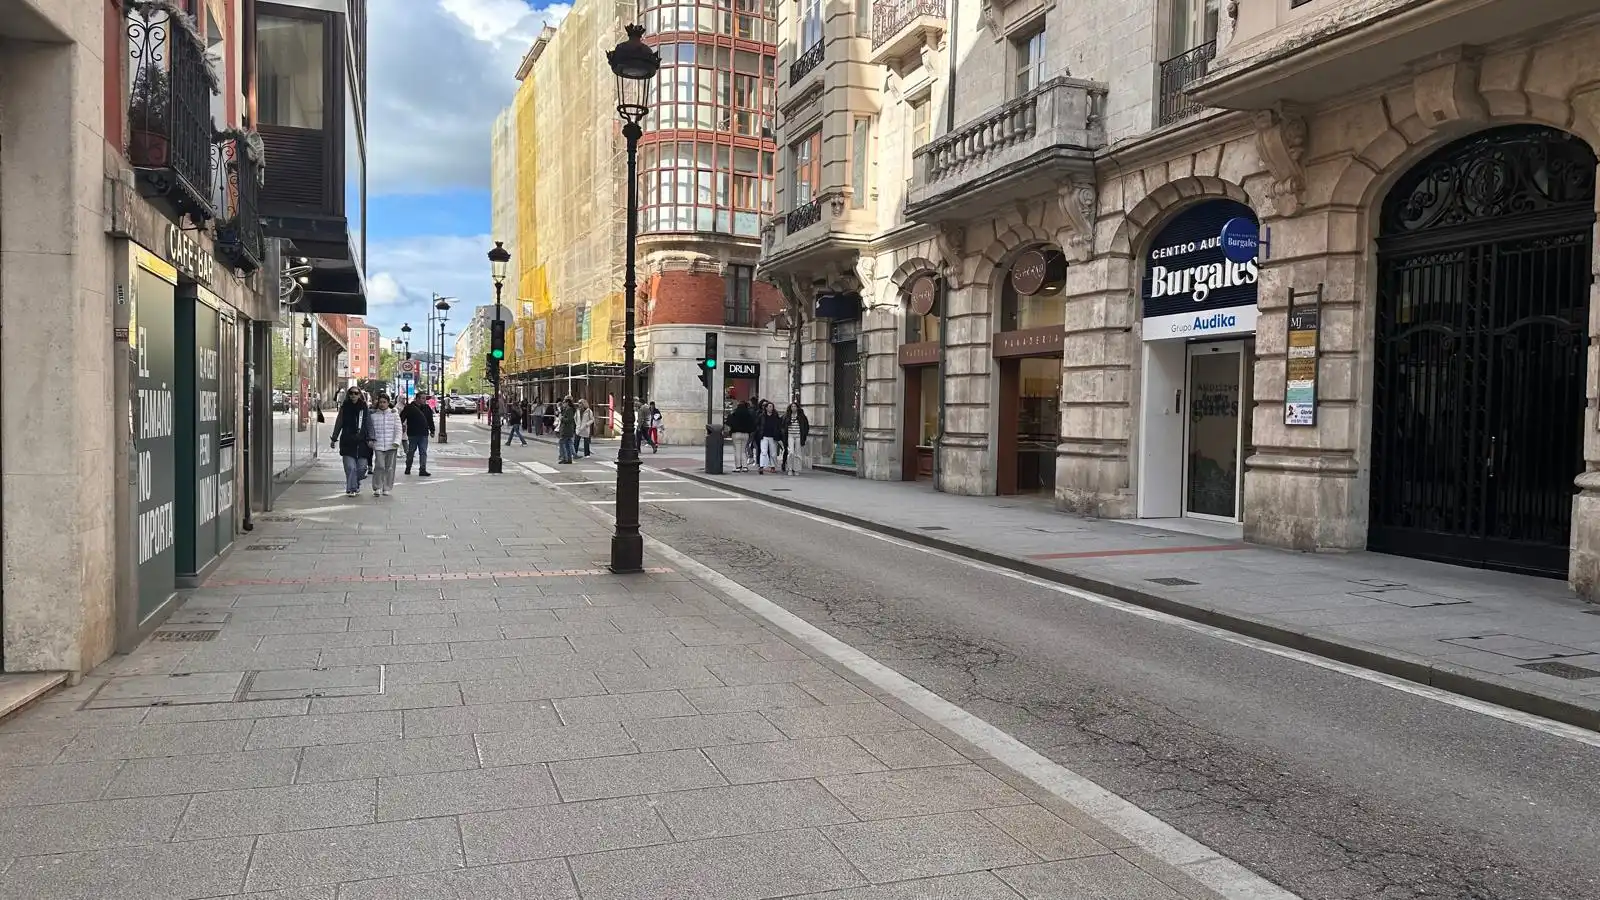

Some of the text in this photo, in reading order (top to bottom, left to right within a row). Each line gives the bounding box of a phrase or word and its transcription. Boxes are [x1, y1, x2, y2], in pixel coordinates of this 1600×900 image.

[1152, 242, 1195, 259] CENTRO
[1228, 237, 1257, 248] Burgales
[1151, 257, 1258, 302] Burgales
[1171, 314, 1236, 333] Grupo Audika
[138, 326, 150, 378] EL
[729, 364, 755, 374] DRUNI
[138, 381, 172, 439] TAMAÑO
[139, 451, 152, 502] NO
[139, 501, 174, 565] IMPORTA
